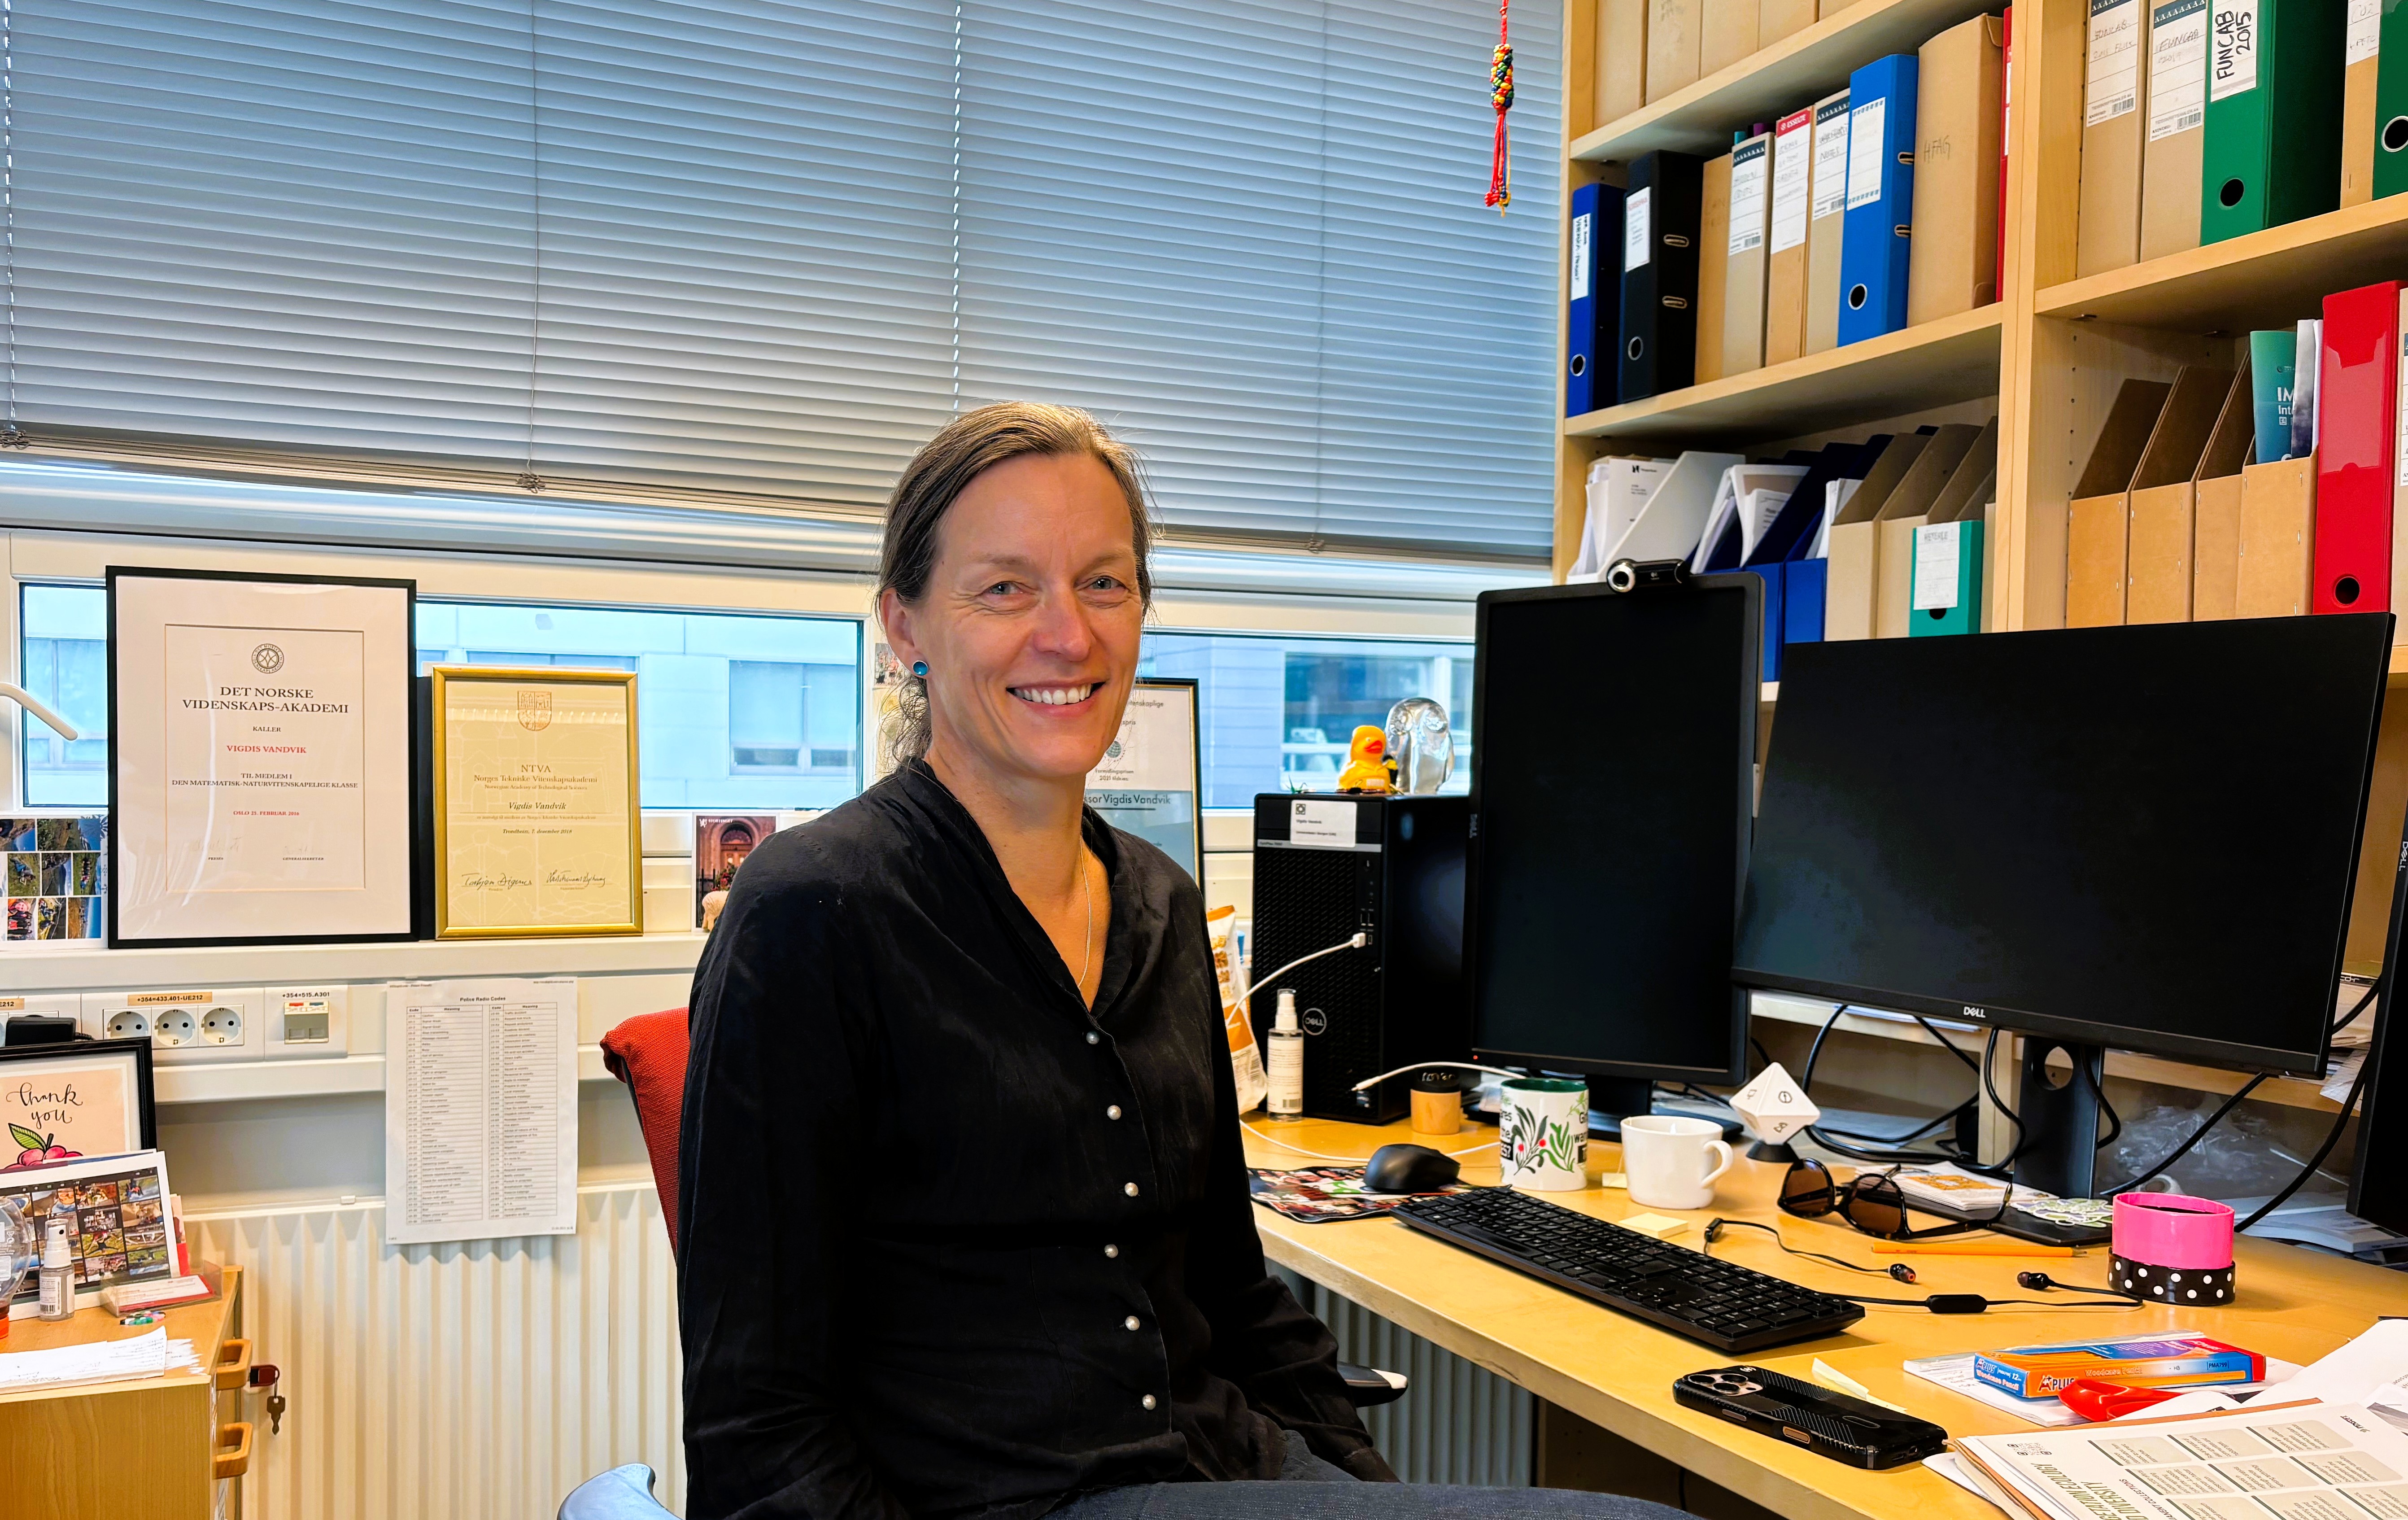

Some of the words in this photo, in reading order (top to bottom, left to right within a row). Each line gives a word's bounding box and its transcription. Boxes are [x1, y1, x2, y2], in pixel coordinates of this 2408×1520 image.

[2236, 12, 2251, 55] 2015
[2215, 11, 2235, 80] FUNCAB
[220, 686, 251, 697] DET
[254, 688, 314, 699] NORSKE
[183, 699, 349, 713] VIDENSKAPS-AKADEMI
[521, 764, 551, 773] NTVA
[509, 802, 532, 811] Vigdis
[536, 802, 567, 810] Vandvik
[1103, 794, 1132, 806] Vigdis
[1133, 794, 1171, 804] Vandvik
[2398, 841, 2408, 872] DELL
[1305, 1017, 1324, 1026] DELL
[1963, 1006, 1986, 1018] DELL
[31, 1109, 72, 1130] you
[1976, 1370, 2002, 1385] Woodcase
[2002, 1378, 2020, 1391] Pencil
[2085, 1368, 2121, 1377] Woodcase
[2122, 1365, 2143, 1375] Pencil
[2031, 1463, 2081, 1490] ECOLOGY
[2081, 1482, 2141, 1514] DIVERSITY
[2119, 1479, 2156, 1504] COLLECTIONS
[2065, 1490, 2122, 1520] GETATION
